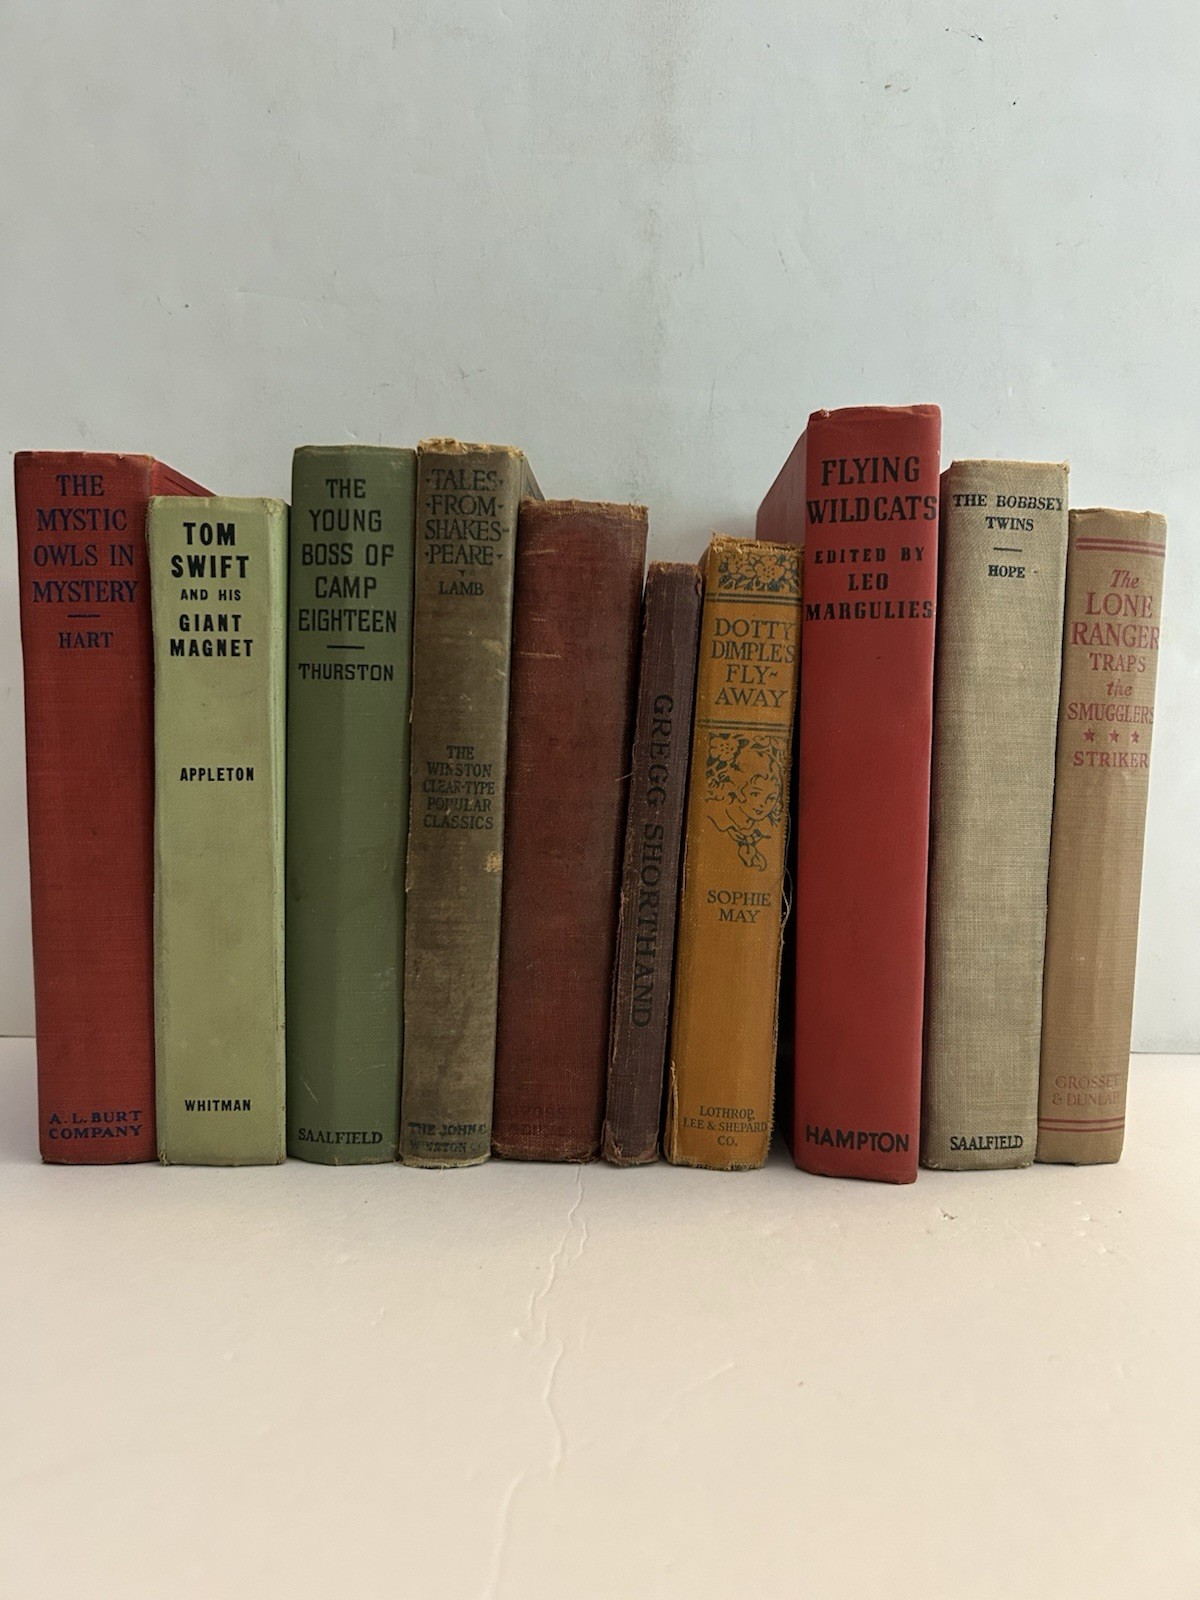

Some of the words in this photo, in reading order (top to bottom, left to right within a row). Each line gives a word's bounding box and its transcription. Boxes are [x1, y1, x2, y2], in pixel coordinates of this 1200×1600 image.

[431, 468, 498, 492] TALES
[821, 456, 920, 486] FLYING
[56, 474, 105, 497] THE
[325, 478, 366, 499] THE
[431, 494, 497, 517] FROM
[806, 496, 937, 525] WILDCATS
[952, 494, 987, 508] THE
[996, 495, 1064, 512] BOBBSEY
[37, 508, 127, 532] MYSTIC
[308, 509, 382, 533] YOUNG
[985, 516, 1034, 531] TWINS
[183, 522, 236, 546] TOM
[33, 544, 98, 567] OWLS
[109, 543, 134, 567] IN
[301, 543, 354, 567] BOSS
[365, 543, 394, 567] OF
[428, 544, 494, 566] PEARE
[814, 547, 886, 564] EDITED
[901, 546, 925, 562] BY
[171, 555, 249, 579] SWIFT
[987, 564, 1026, 579] HOPE
[314, 575, 377, 599] CAMP
[847, 573, 889, 591] LEO
[1111, 569, 1139, 589] The
[33, 580, 139, 603] MYSTERY
[180, 588, 209, 601] AND
[218, 588, 242, 601] HIS
[438, 581, 485, 596] LAMB
[805, 600, 933, 622] MARGULIES
[1085, 592, 1153, 618] LONE
[179, 614, 242, 632] GIANT
[298, 608, 397, 633] EIGHTEEN
[714, 617, 795, 641] DOTTY
[58, 632, 113, 649] HART
[1070, 621, 1160, 650] RANGER
[169, 638, 253, 657] MAGNET
[1089, 652, 1146, 673] TRAPS
[298, 663, 394, 682] THURSTON
[1107, 678, 1133, 696] the
[715, 687, 789, 708] AWAY
[1067, 702, 1154, 724] SMUGGLERS
[446, 745, 475, 760] THE
[647, 694, 674, 806] GREGG
[1073, 751, 1149, 768] STRIKER
[180, 767, 255, 781] APPLETON
[426, 761, 493, 778] WINSTON
[423, 779, 496, 795] CLEAR-TYPE
[426, 796, 492, 812] POPULAR
[423, 813, 494, 830] CLASSICS
[707, 890, 771, 907] SOPHIE
[719, 908, 760, 923] MAY
[631, 824, 664, 1028] SHORTHAND
[185, 1099, 251, 1112] WHITMAN
[1052, 1093, 1061, 1106] &
[92, 1110, 142, 1123] BURT
[682, 1117, 704, 1129] LEE
[707, 1120, 716, 1131] &
[719, 1121, 768, 1132] SHEPARD
[48, 1124, 143, 1140] COMPANY
[298, 1128, 383, 1145] SAALFIELD
[408, 1121, 436, 1136] THE
[439, 1123, 477, 1137] JOHN
[410, 1140, 467, 1153] WSTON
[717, 1135, 738, 1147] CO.
[806, 1124, 910, 1153] HAMPTON
[950, 1134, 1023, 1150] SAALFIELD
